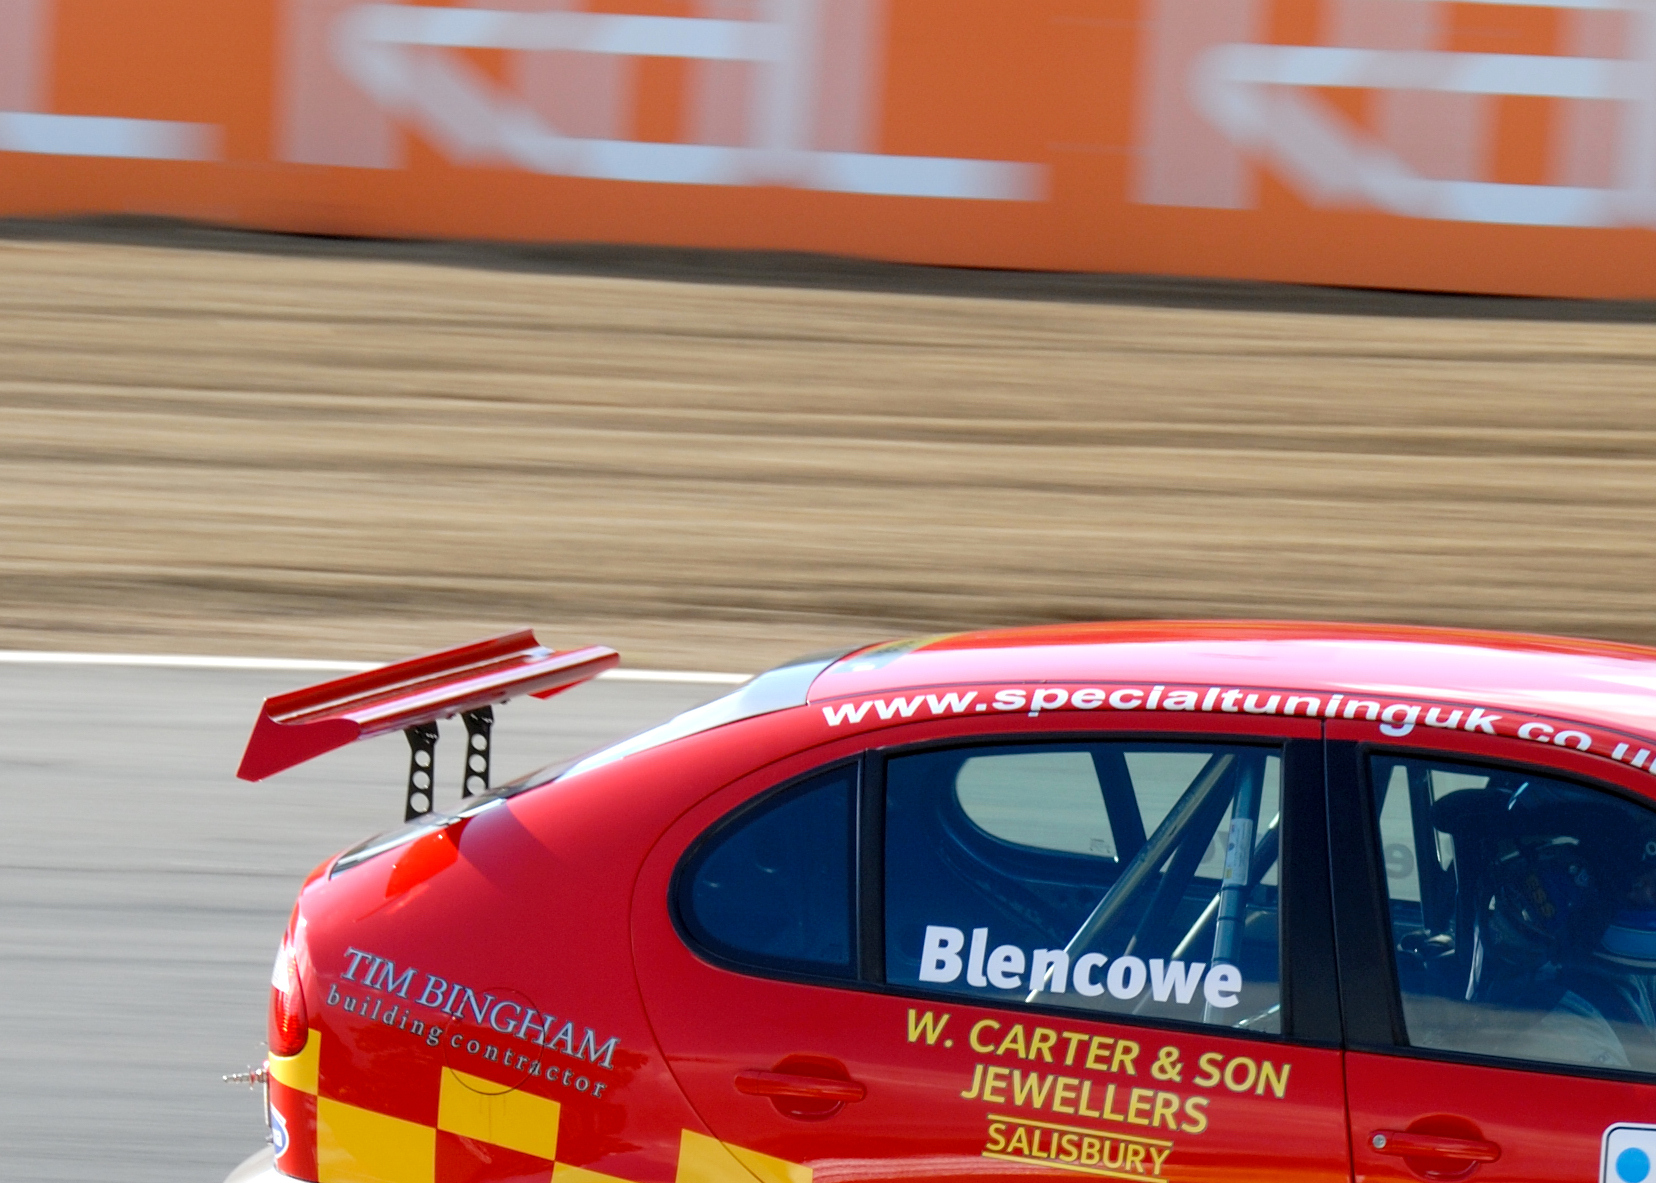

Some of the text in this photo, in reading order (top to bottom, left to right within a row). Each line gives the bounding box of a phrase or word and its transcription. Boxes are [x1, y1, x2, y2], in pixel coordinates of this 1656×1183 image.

[341, 946, 620, 1069] TIM BINGHAM
[919, 925, 1243, 1008] Blencowe
[327, 984, 607, 1098] building contractor
[906, 1008, 1292, 1098] W. CARTER & SON
[961, 1063, 1209, 1134] JEWELLERS
[985, 1123, 1172, 1175] SALISBURY
